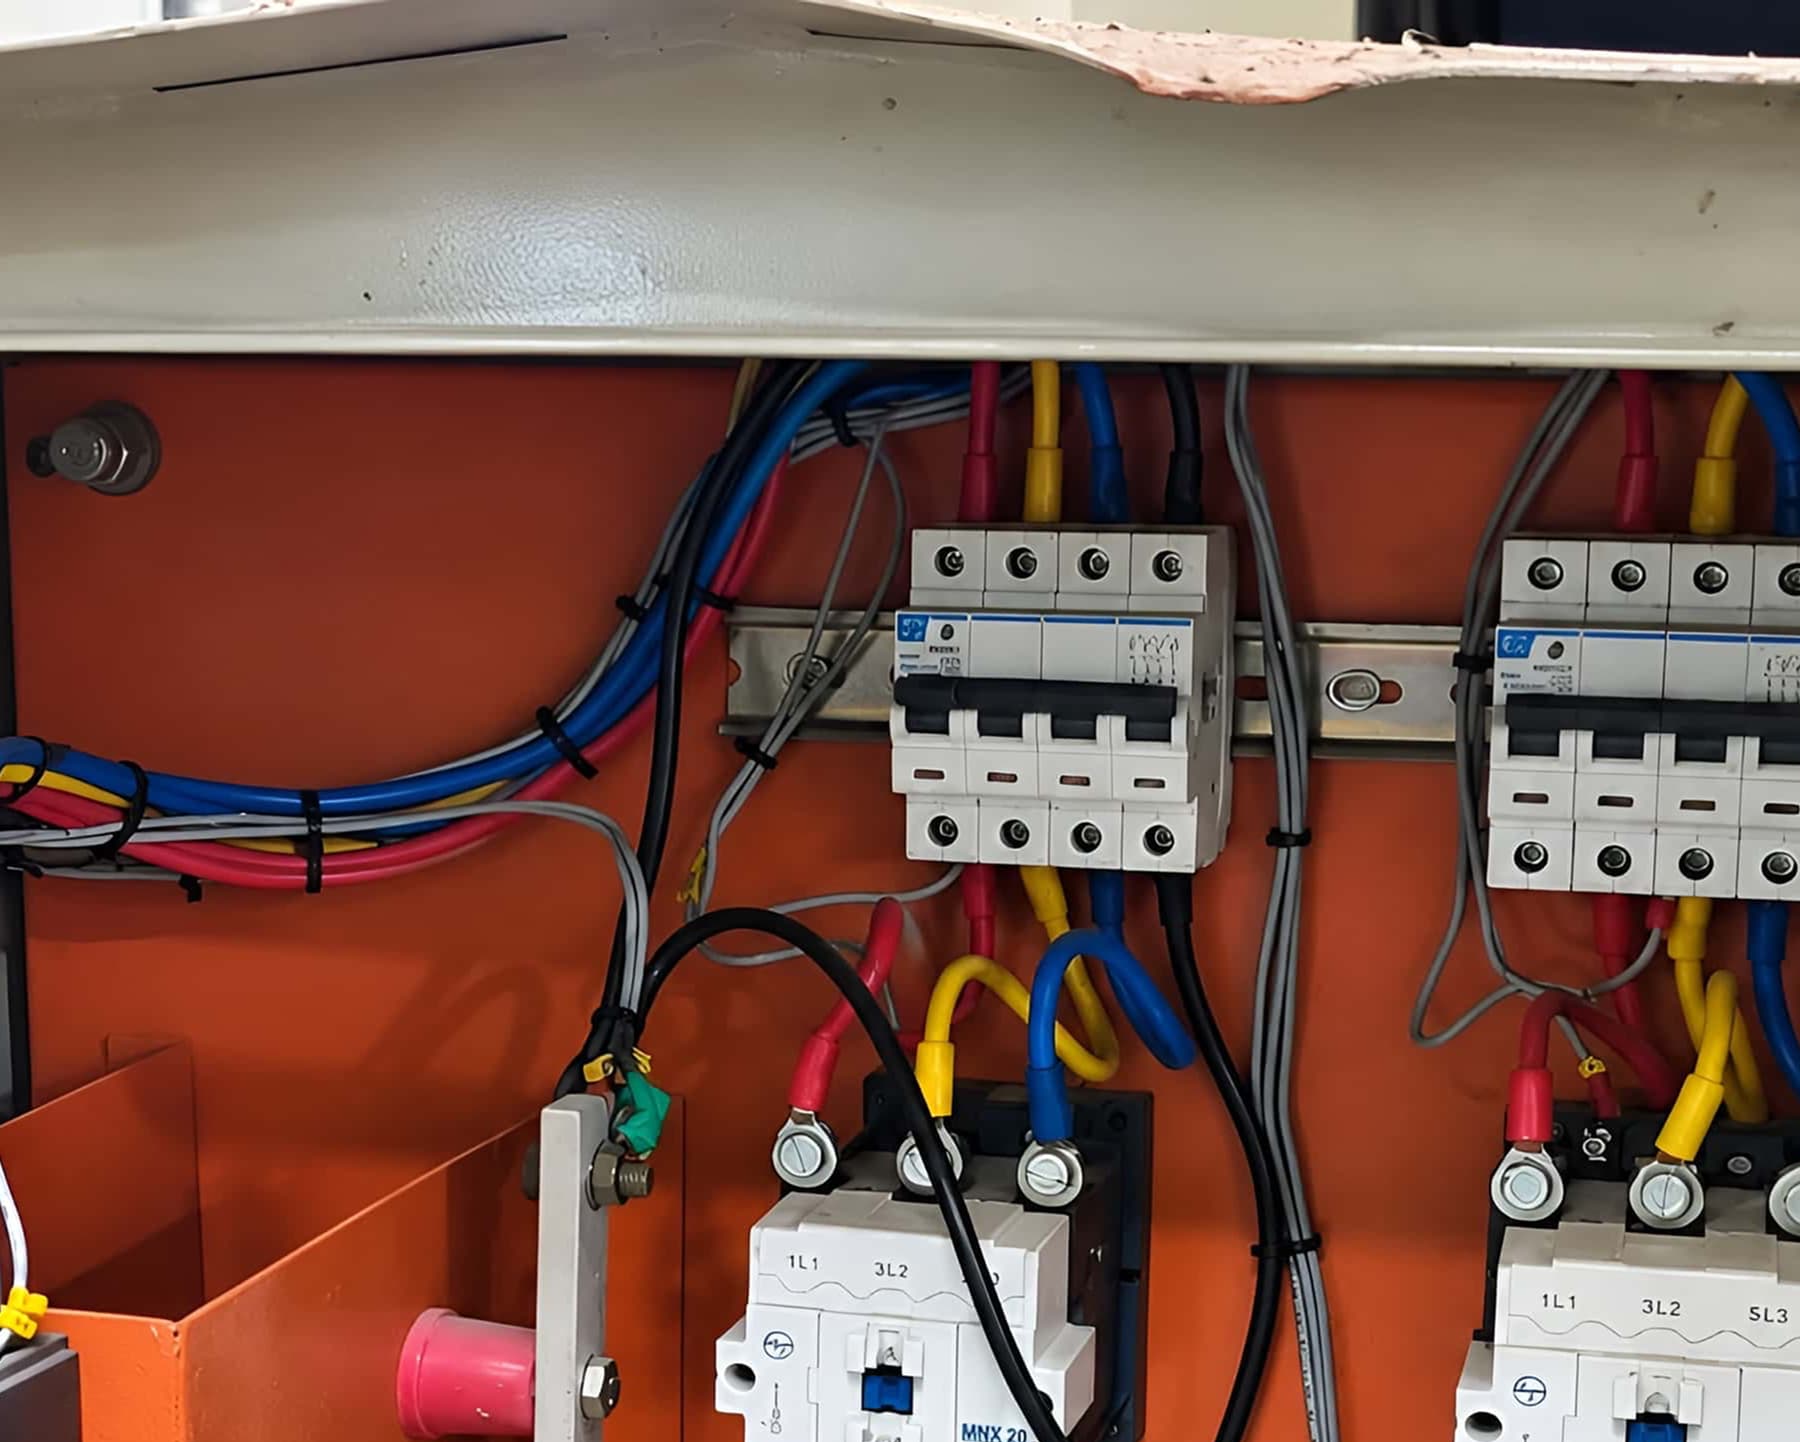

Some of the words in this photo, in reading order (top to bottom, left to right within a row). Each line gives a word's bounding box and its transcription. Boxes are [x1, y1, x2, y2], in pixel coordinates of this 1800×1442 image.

[787, 1255, 818, 1271] 1L1
[874, 1261, 908, 1279] 3L2
[1541, 1293, 1575, 1310] 1L1
[1642, 1299, 1681, 1317] 3L2
